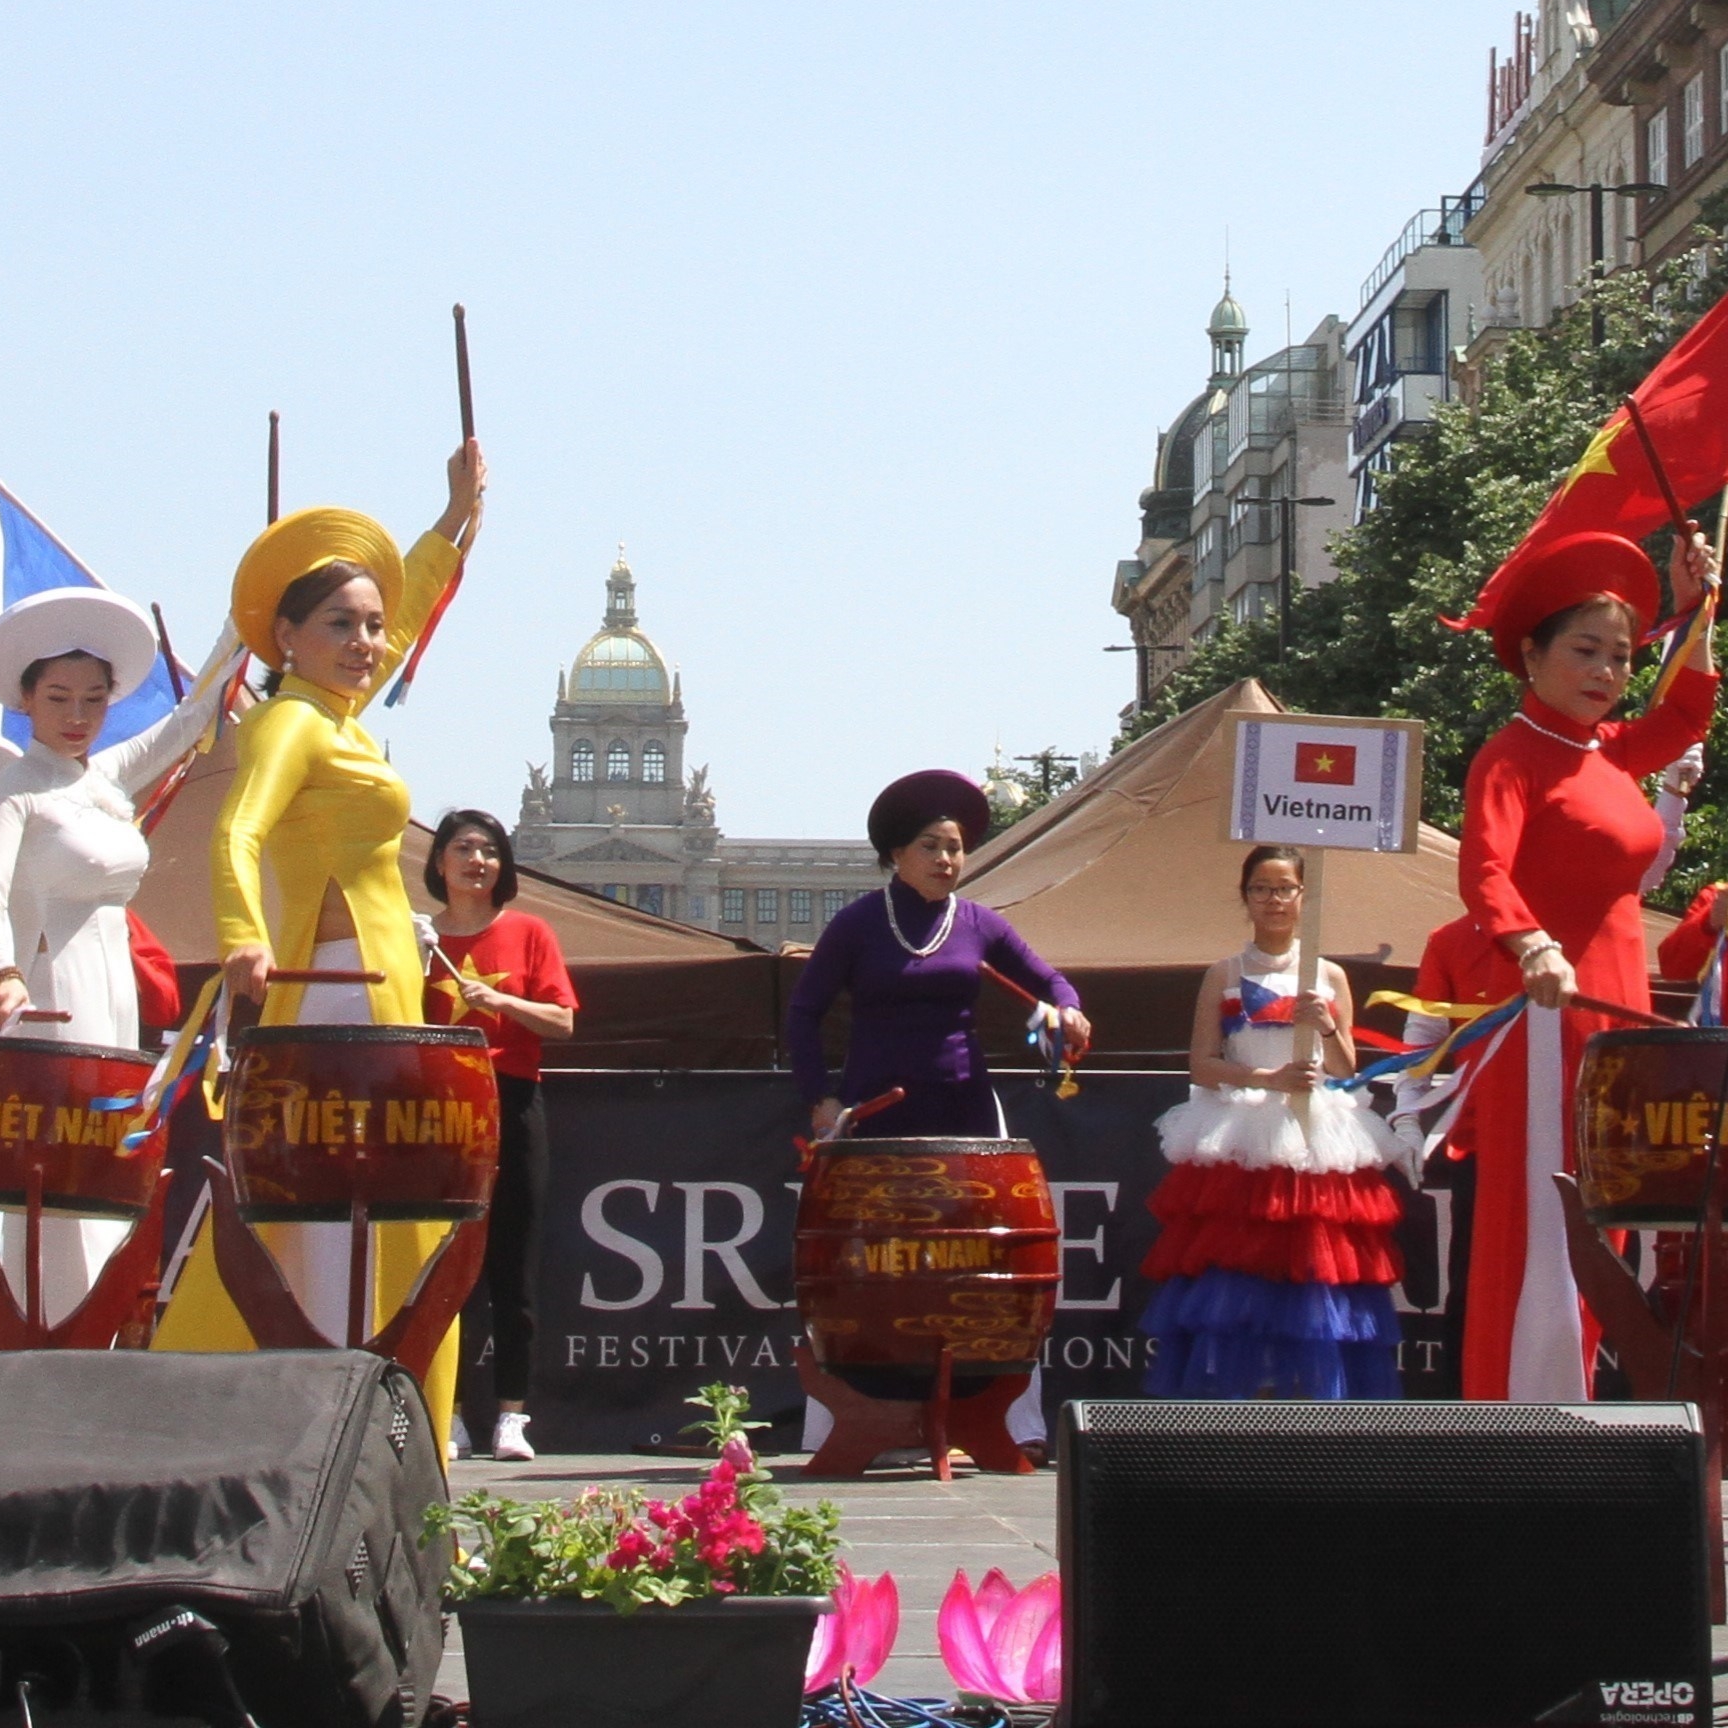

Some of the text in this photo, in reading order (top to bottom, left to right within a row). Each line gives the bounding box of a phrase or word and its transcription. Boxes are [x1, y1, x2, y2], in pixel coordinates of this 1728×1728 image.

[1263, 793, 1372, 822] Vietnam
[281, 1088, 474, 1155] VIỆT NAM
[580, 1178, 1121, 1310] SRE
[864, 1236, 992, 1278] VIỆT NAM
[1599, 1682, 1695, 1705] OPERA
[1600, 1712, 1695, 1725] dBTechnologies
